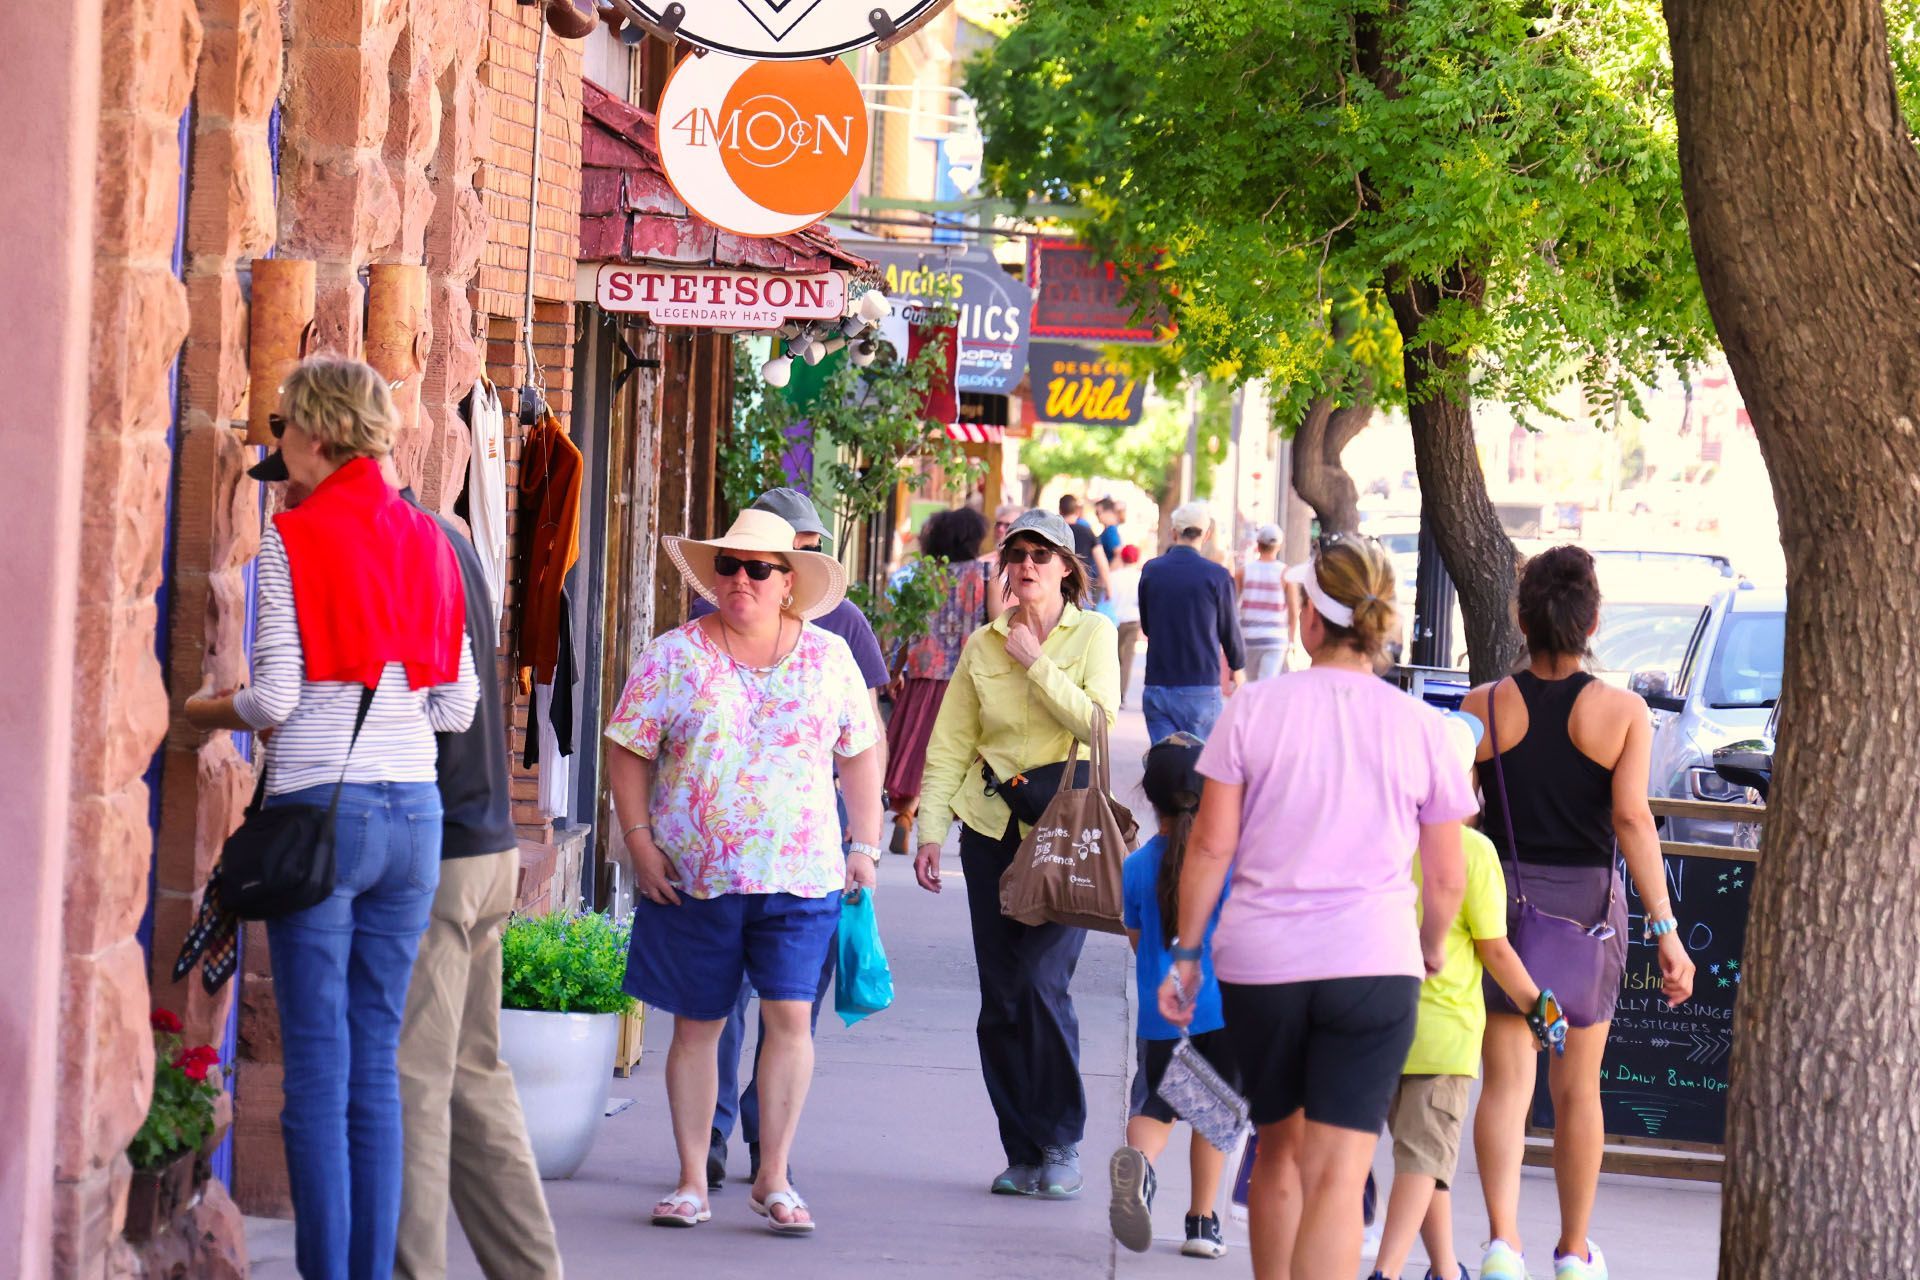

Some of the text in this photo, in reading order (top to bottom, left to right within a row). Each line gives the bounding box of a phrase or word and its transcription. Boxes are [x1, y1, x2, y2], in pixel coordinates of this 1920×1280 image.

[655, 306, 778, 323] LEGENDARY HATS
[957, 374, 1007, 388] SONY
[1045, 376, 1137, 421] Wild
[1640, 1019, 1711, 1033] STICKERS
[1616, 1064, 1656, 1084] DAILY
